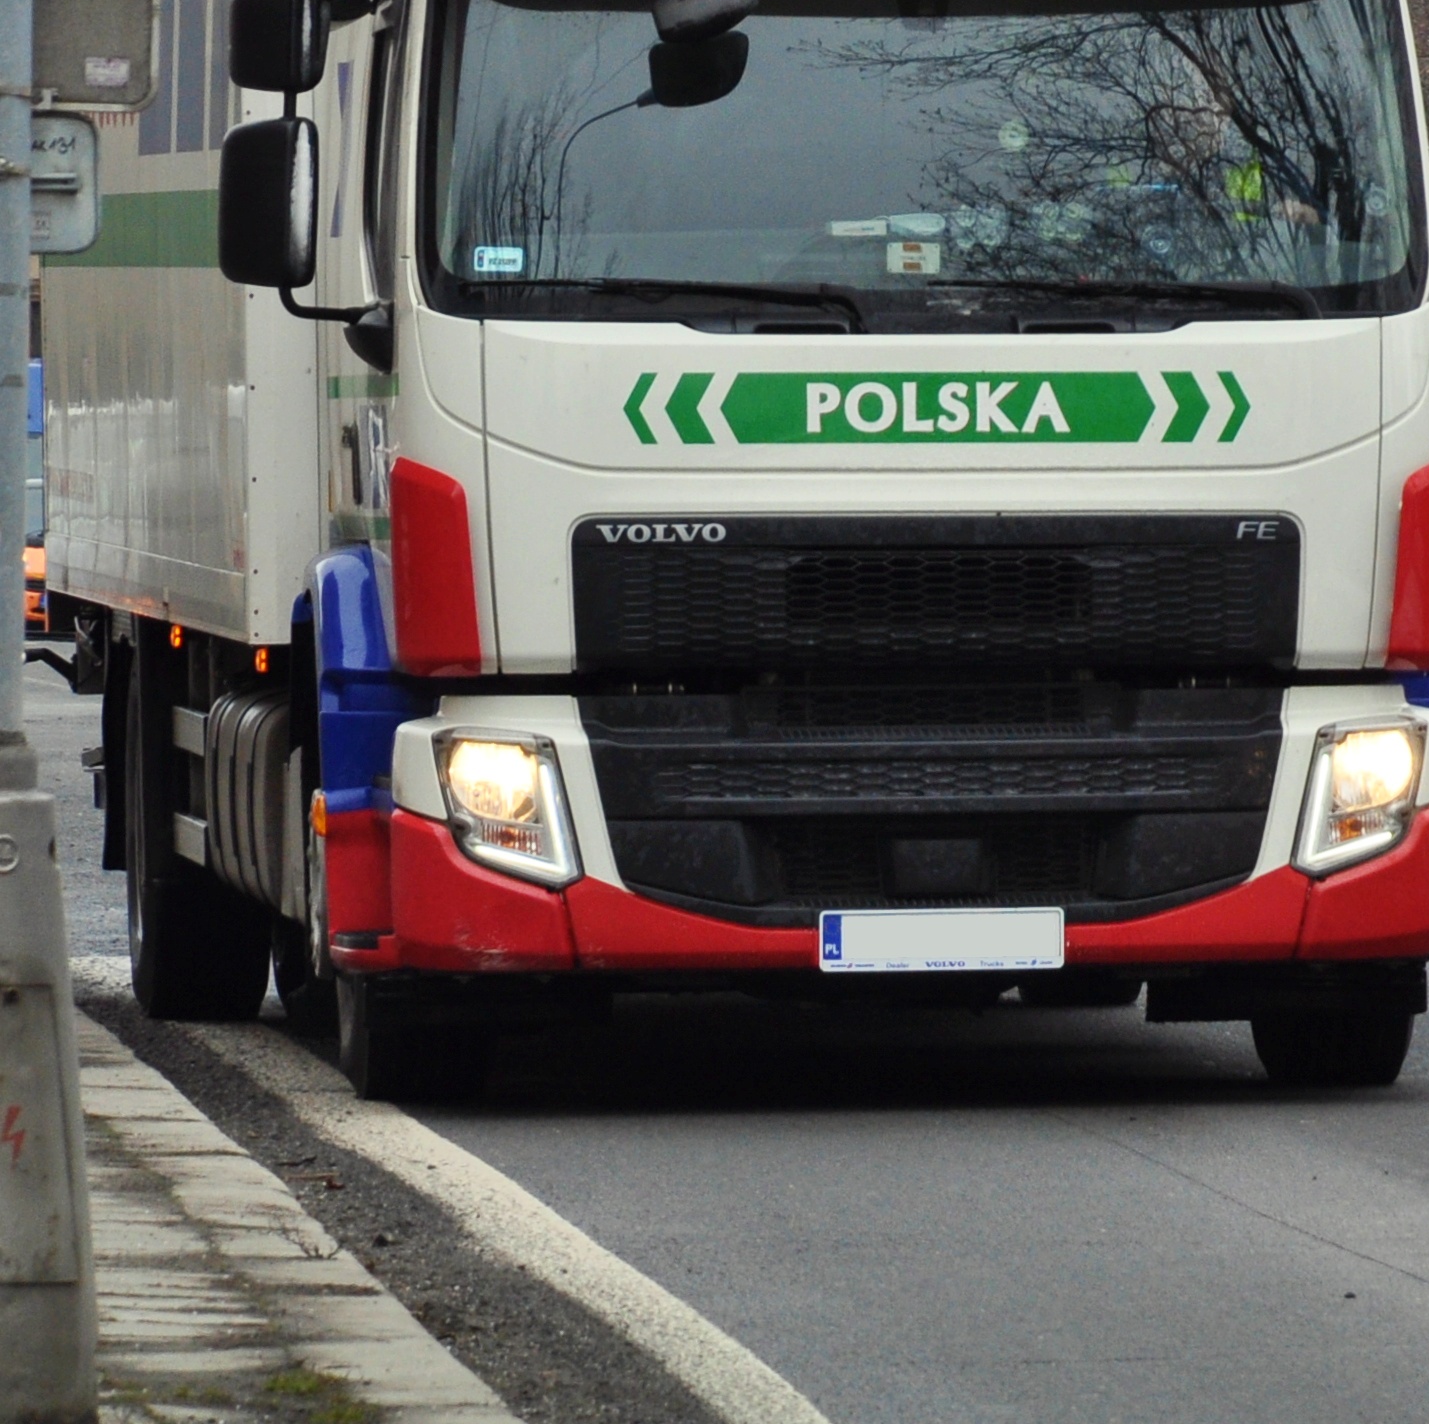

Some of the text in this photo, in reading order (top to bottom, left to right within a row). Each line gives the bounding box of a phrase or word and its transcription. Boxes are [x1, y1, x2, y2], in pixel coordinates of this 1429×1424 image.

[804, 381, 1071, 435] POLSKA
[595, 522, 727, 544] VOLVO
[1236, 520, 1281, 541] FE
[823, 943, 839, 956] PL
[885, 961, 910, 970] Dealer
[924, 960, 966, 968] VOLVO
[979, 959, 1005, 968] Trucks
